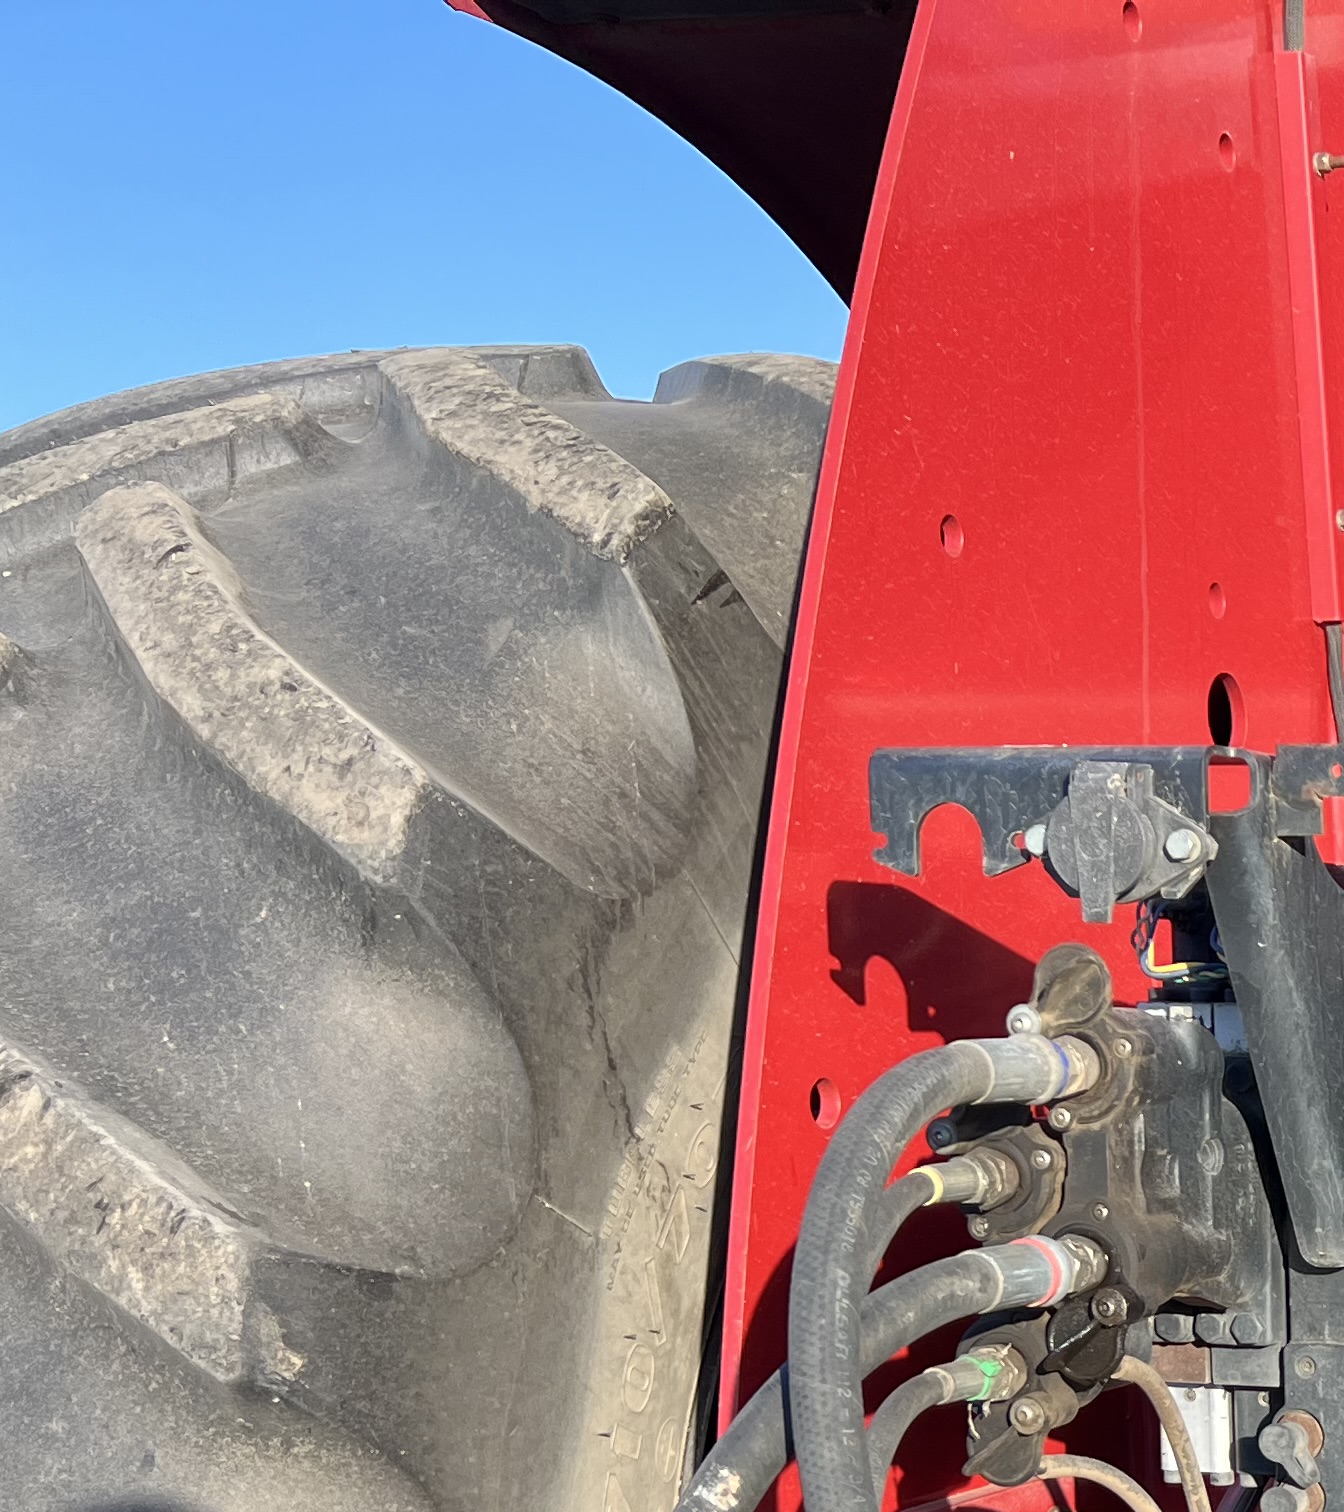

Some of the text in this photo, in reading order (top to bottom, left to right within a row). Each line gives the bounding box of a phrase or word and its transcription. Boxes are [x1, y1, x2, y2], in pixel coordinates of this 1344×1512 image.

[600, 1045, 682, 1240] TUBELESS
[606, 1240, 623, 1291] MAY
[634, 1144, 657, 1197] USED
